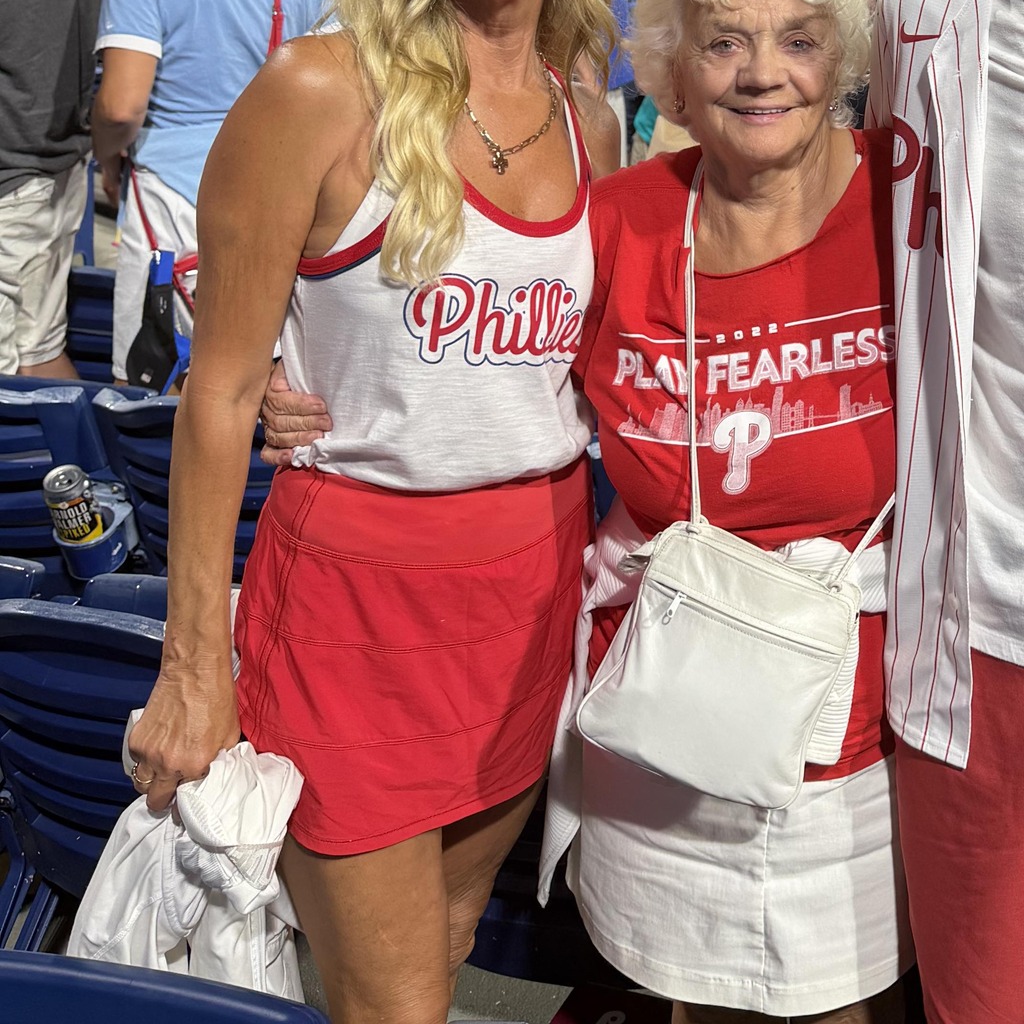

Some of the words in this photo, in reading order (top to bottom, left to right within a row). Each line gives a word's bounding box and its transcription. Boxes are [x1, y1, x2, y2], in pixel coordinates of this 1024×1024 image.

[404, 274, 587, 366] Phillie
[715, 322, 778, 344] 2022
[612, 348, 700, 396] PLAY
[705, 324, 897, 395] FEARLESS
[712, 410, 774, 495] P
